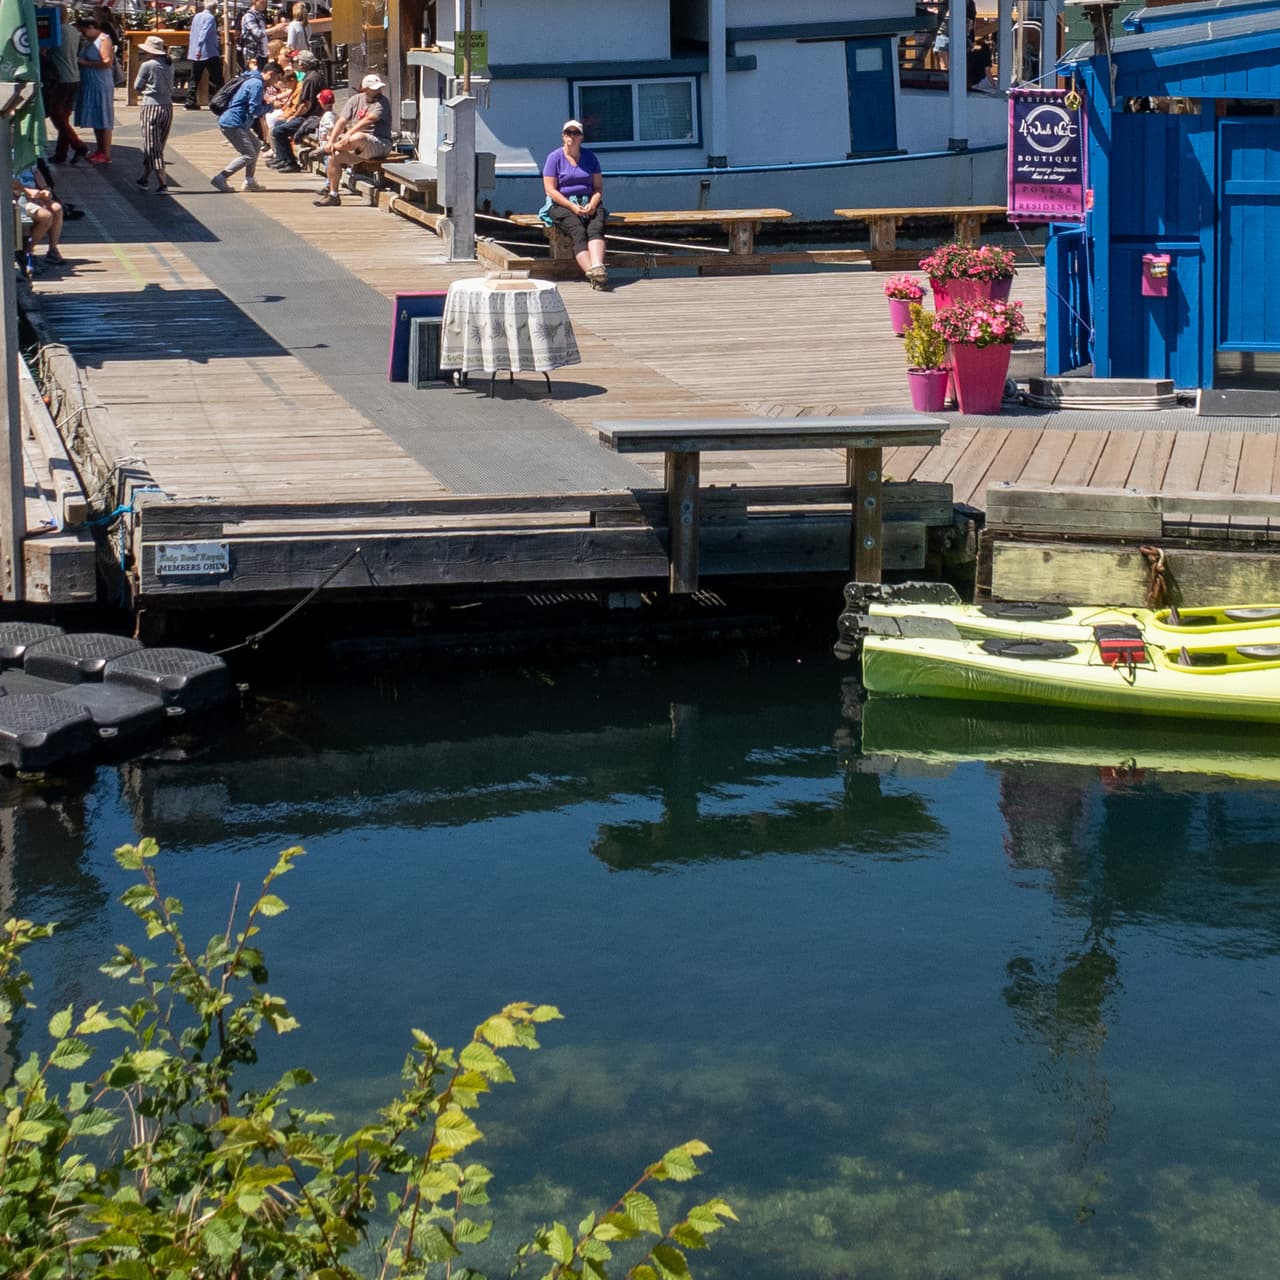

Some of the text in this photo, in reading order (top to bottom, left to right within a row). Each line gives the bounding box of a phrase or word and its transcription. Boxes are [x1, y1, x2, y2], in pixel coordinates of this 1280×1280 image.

[1018, 202, 1079, 211] RESIDENCE
[160, 562, 226, 572] MEMBERS ONLY
